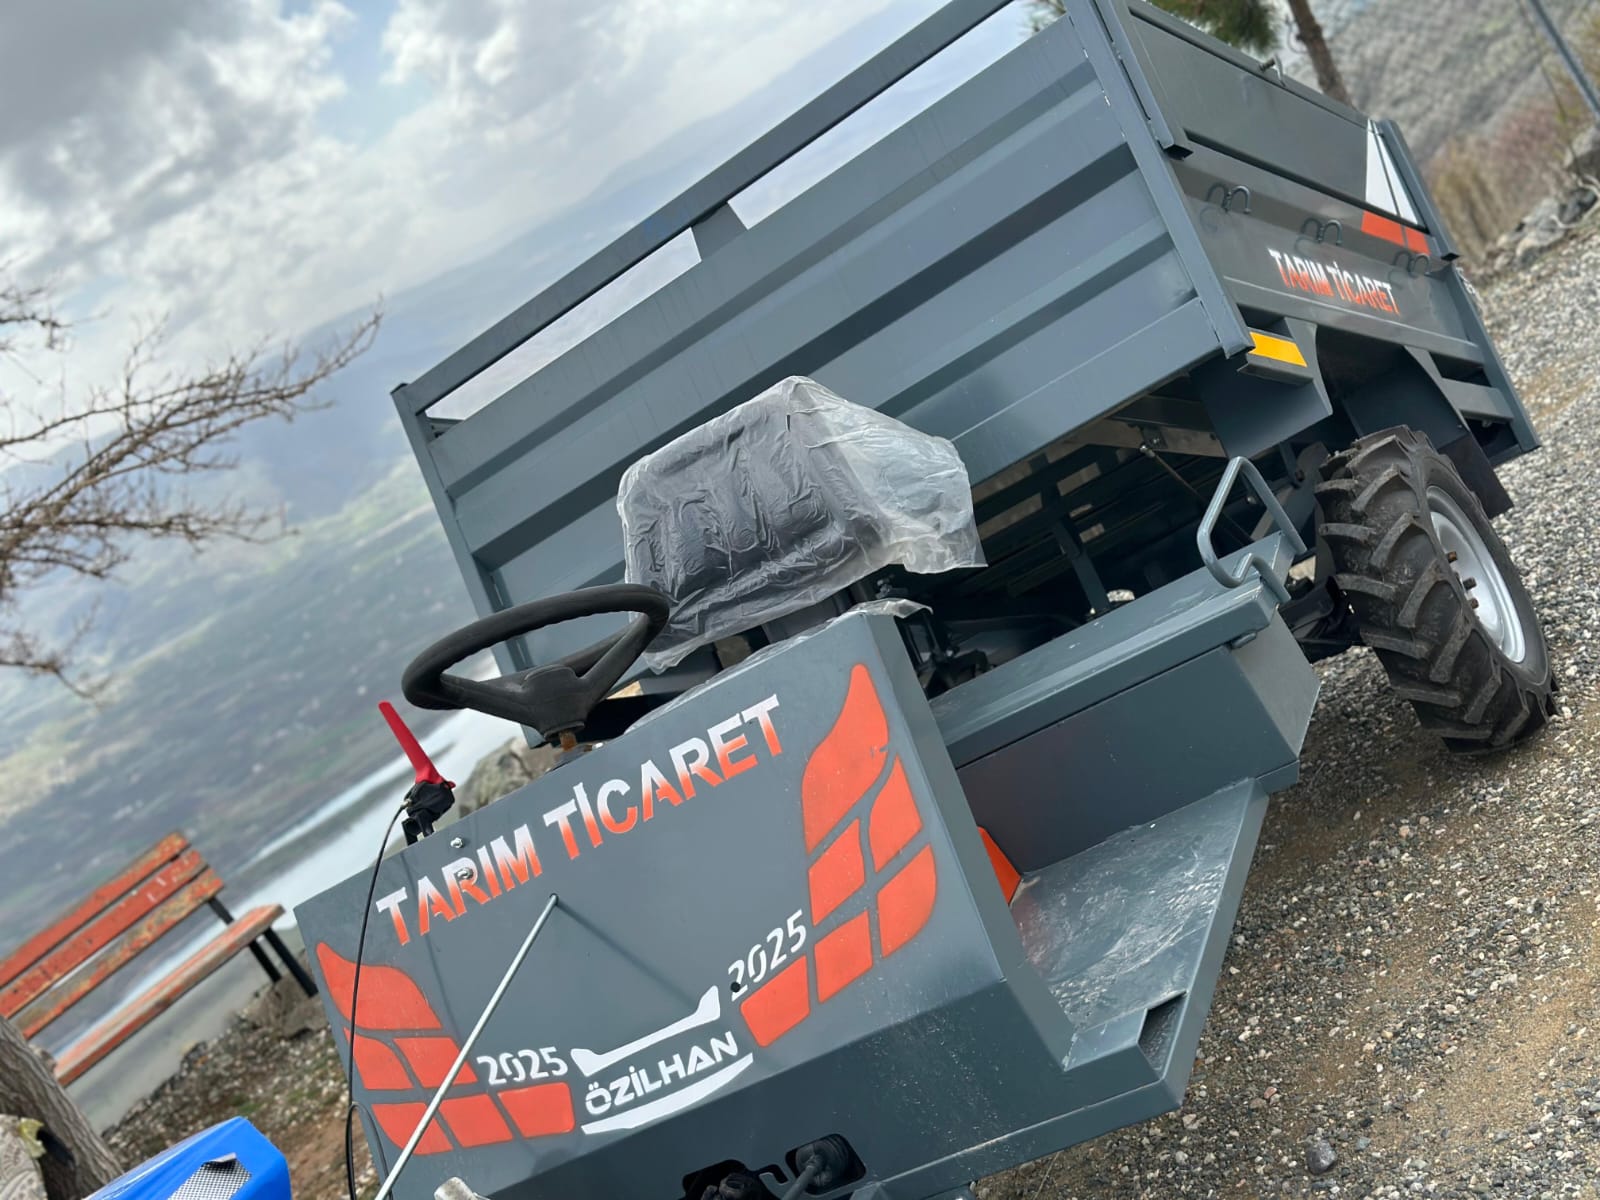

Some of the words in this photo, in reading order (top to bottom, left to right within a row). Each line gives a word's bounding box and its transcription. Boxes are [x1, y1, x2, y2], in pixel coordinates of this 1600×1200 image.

[1267, 247, 1335, 297] TARIM
[375, 823, 543, 946] TARIM
[728, 909, 807, 1002] 2025
[477, 1046, 568, 1086] 2025
[585, 1031, 738, 1115] ÖZİLHAN
